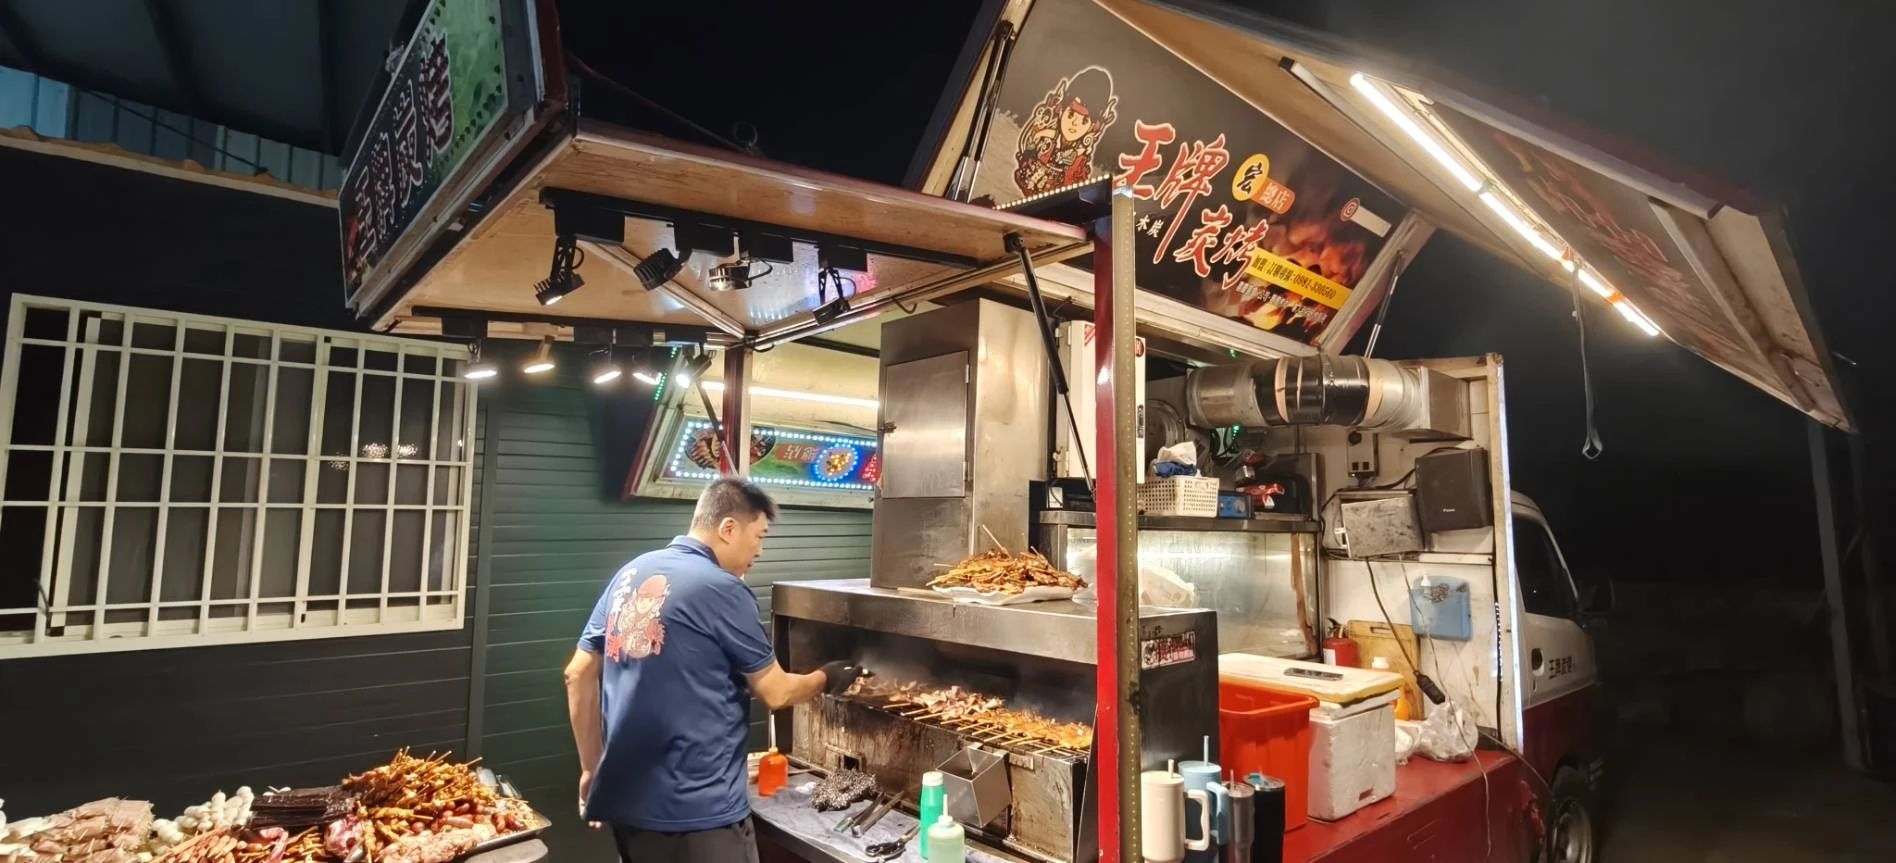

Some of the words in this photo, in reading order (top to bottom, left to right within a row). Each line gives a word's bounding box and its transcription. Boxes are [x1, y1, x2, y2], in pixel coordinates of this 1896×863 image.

[355, 29, 455, 260] 王牌炭烤
[1112, 120, 1229, 264] 王牌
[1132, 211, 1165, 238] 木炭
[1173, 204, 1269, 289] 炭烤
